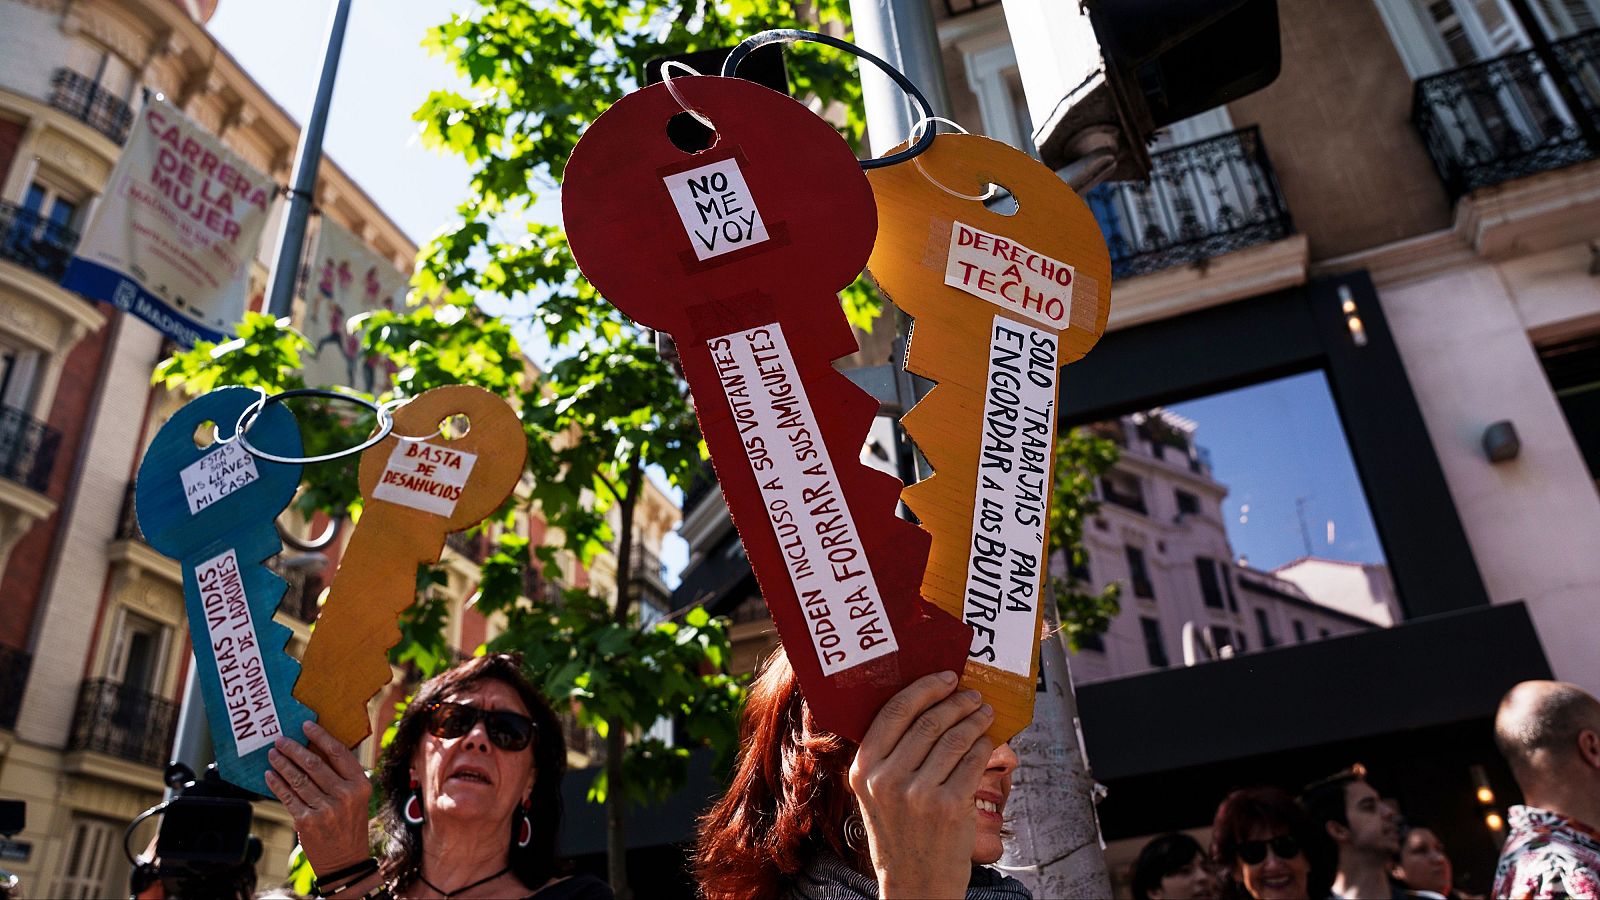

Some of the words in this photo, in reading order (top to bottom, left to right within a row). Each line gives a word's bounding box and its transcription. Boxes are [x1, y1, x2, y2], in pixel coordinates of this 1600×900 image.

[146, 110, 268, 213] CARRERA
[159, 148, 196, 188] DE
[200, 179, 234, 216] LA
[151, 165, 241, 245] MUJER
[687, 172, 728, 198] NO
[695, 191, 743, 225] ME
[695, 210, 755, 251] VOY
[957, 226, 1072, 286] DERECHO
[1002, 264, 1022, 283] A
[957, 260, 1064, 321] TECHO
[745, 329, 805, 429] AMIGUETES
[1027, 331, 1056, 388] SOLO
[708, 338, 759, 433] VOTANTES
[982, 325, 1025, 474] ENGORDAR
[200, 444, 235, 470] ESTAS
[211, 459, 227, 472] SON
[405, 443, 462, 470] BASTA
[745, 436, 773, 471] SUS
[788, 427, 818, 461] SUS
[188, 481, 205, 496] LAS
[209, 453, 252, 485] LLAVES
[196, 493, 213, 509] MI
[219, 470, 254, 496] CASA
[214, 479, 227, 488] DE
[382, 470, 462, 501] DESAHUCIOS
[414, 463, 437, 477] DE
[763, 477, 783, 490] A
[802, 462, 827, 475] A
[982, 475, 1004, 491] A
[802, 480, 866, 583] FORRAR
[980, 498, 1003, 534] LOS
[769, 499, 815, 580] INCLUSO
[198, 567, 227, 631] VIDAS
[217, 555, 249, 630] LADRONES
[966, 533, 1006, 662] BUITRES
[1006, 548, 1037, 612] PARA
[802, 589, 846, 665] JODEN
[844, 585, 888, 651] PARA
[237, 630, 254, 653] DE
[214, 636, 257, 741] NUESTRAS
[242, 656, 271, 713] MANOS
[260, 714, 279, 738] EN
